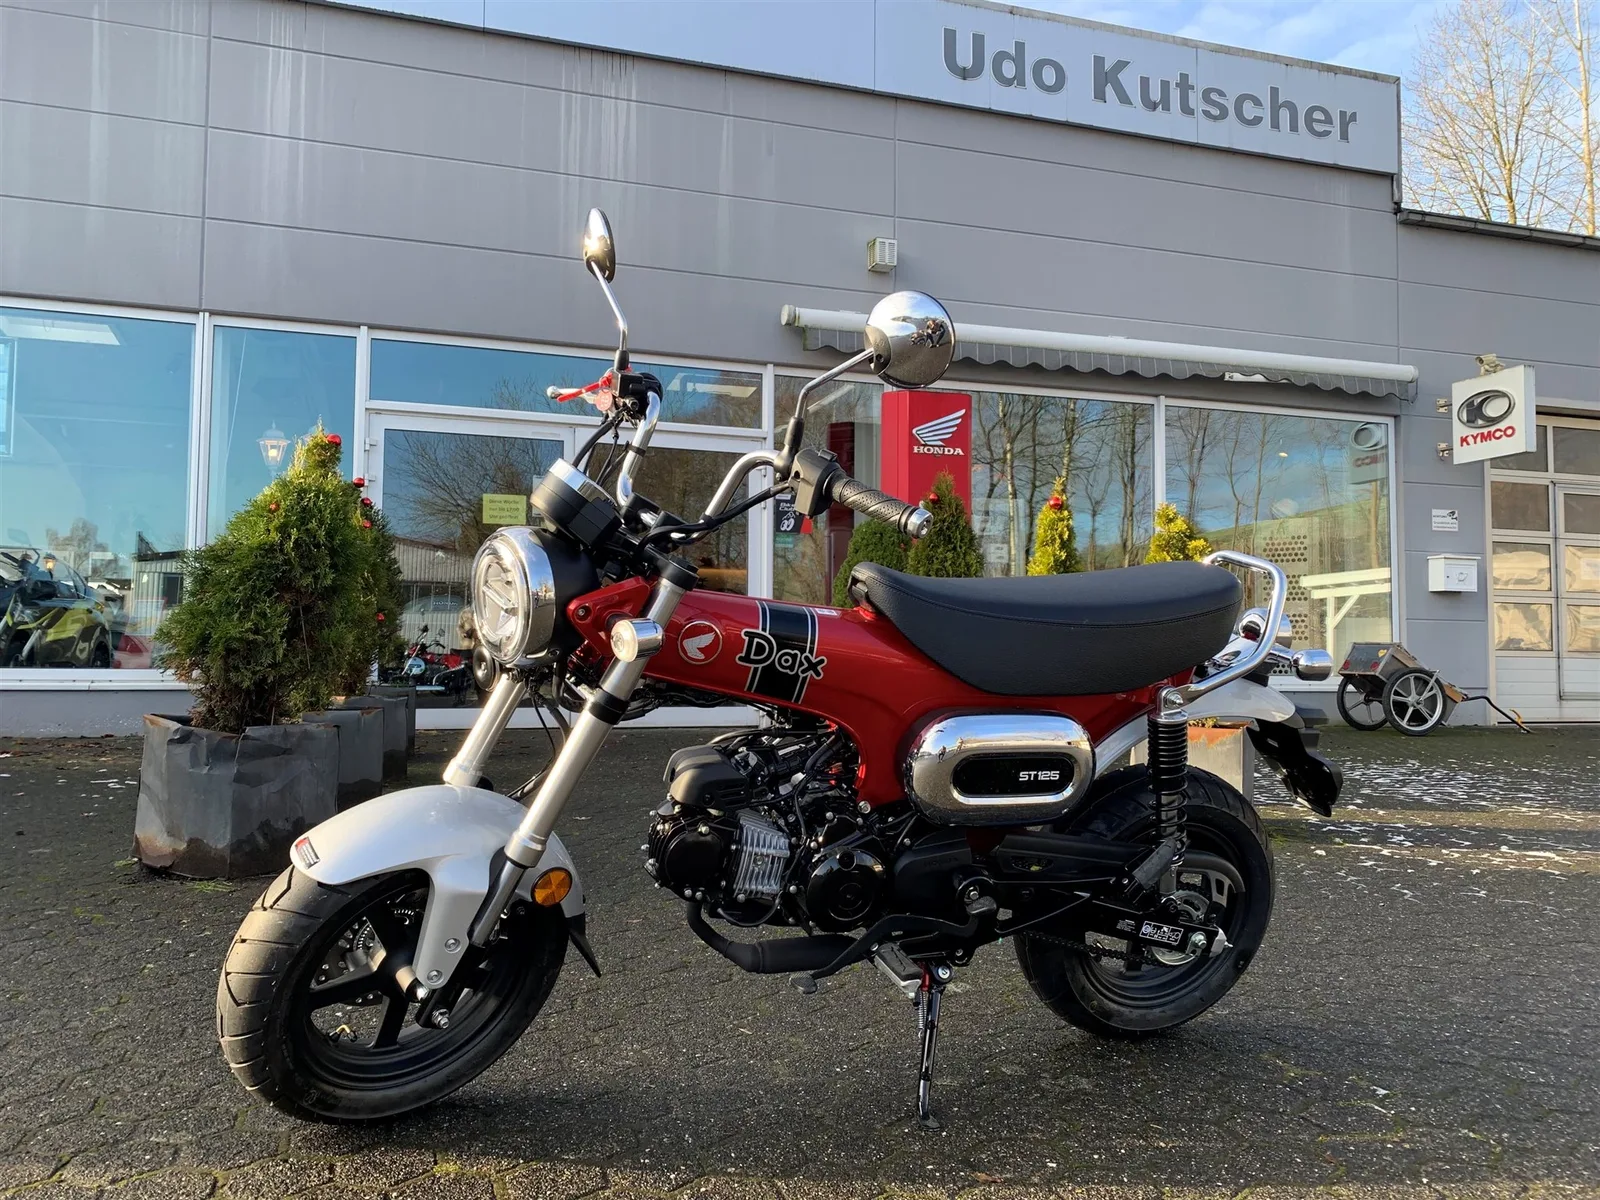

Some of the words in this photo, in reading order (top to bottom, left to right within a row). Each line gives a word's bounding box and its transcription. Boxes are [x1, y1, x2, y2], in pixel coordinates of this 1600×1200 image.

[942, 26, 1067, 94] Udo
[1091, 53, 1359, 143] Kutscher
[1459, 425, 1516, 447] KYMCO
[912, 445, 965, 456] HONDA
[735, 628, 828, 680] Dax
[1018, 770, 1060, 781] ST125
